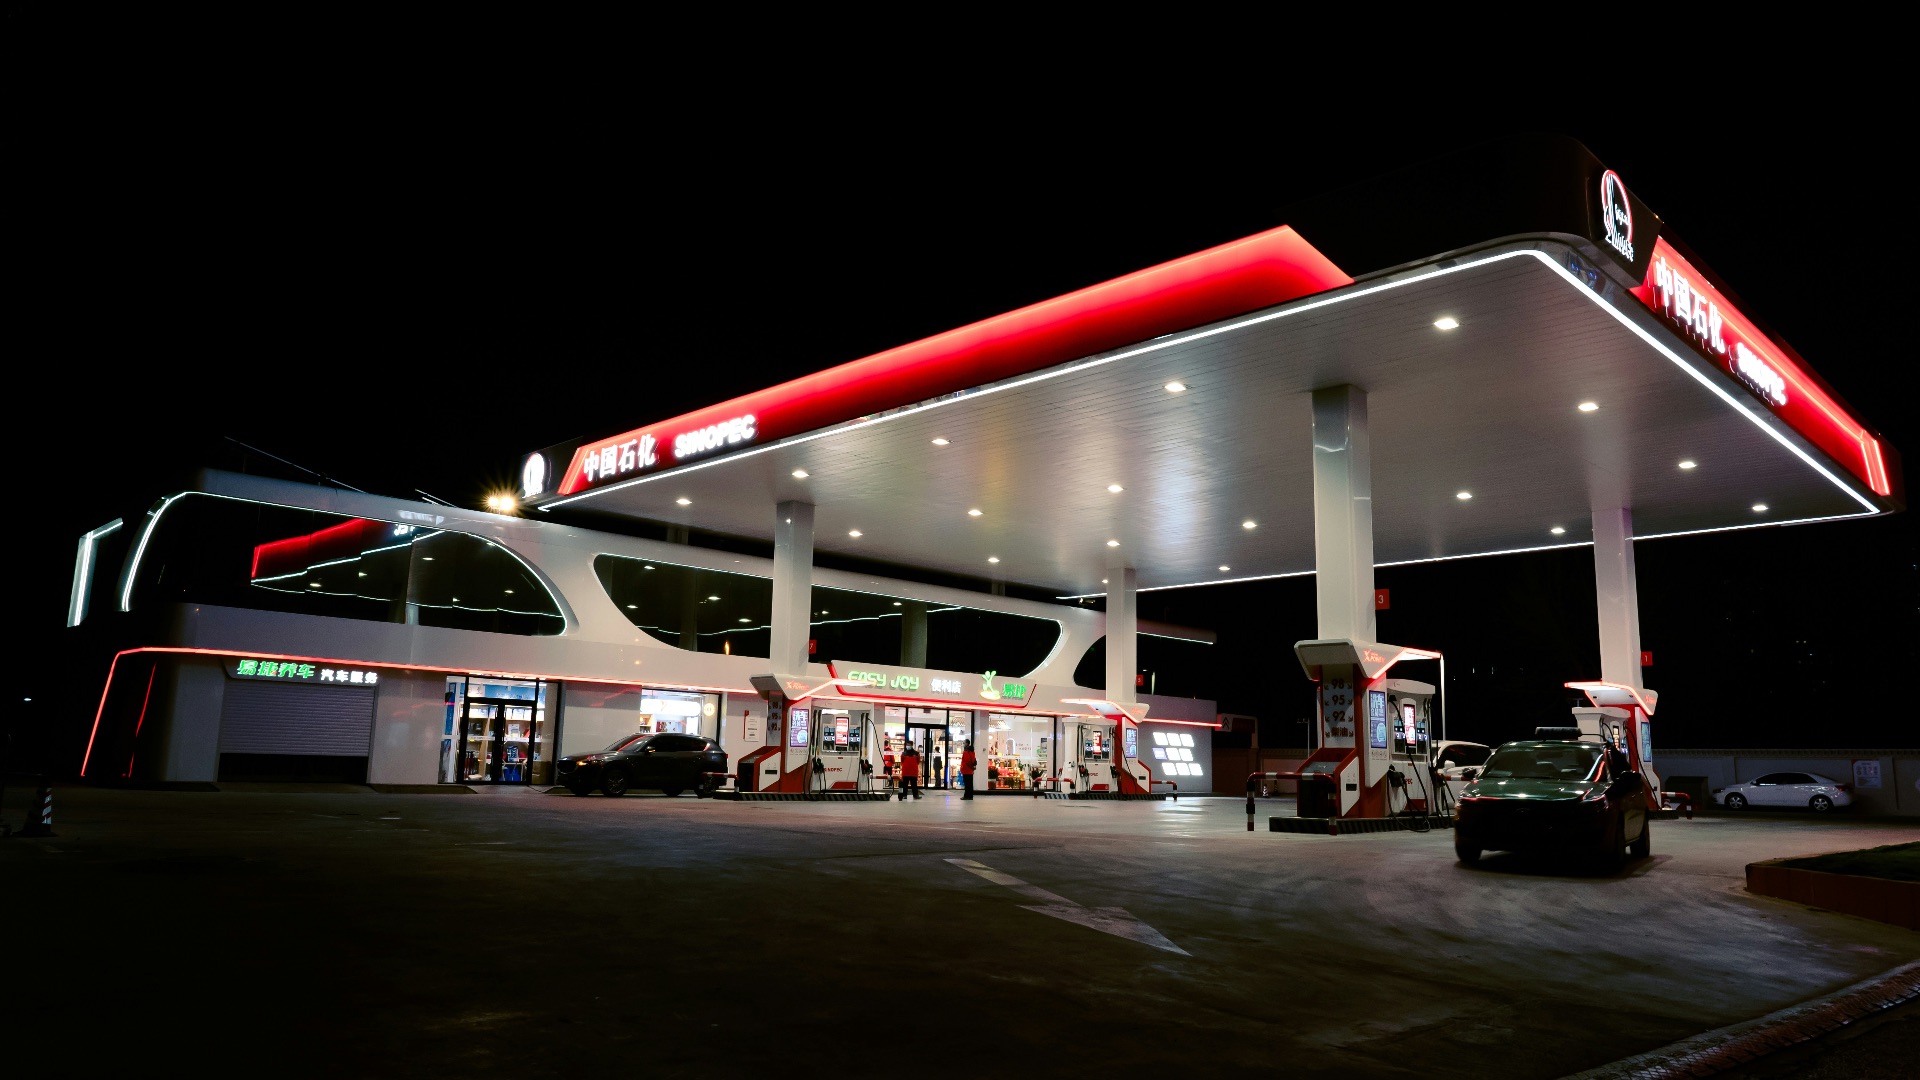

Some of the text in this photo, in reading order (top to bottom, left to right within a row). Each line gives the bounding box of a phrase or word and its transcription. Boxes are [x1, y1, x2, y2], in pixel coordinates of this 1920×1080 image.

[1655, 256, 1725, 354] 中国石化
[674, 414, 756, 459] SINOPEC
[583, 433, 657, 483] 中国石化
[1377, 594, 1384, 604] 3
[237, 659, 378, 684] 易捷养车 汽车服务
[847, 670, 920, 690] EASY JOY
[930, 678, 962, 694] 便利店
[1331, 678, 1345, 690] 98
[1332, 694, 1345, 706] 95
[1332, 710, 1346, 722] 92
